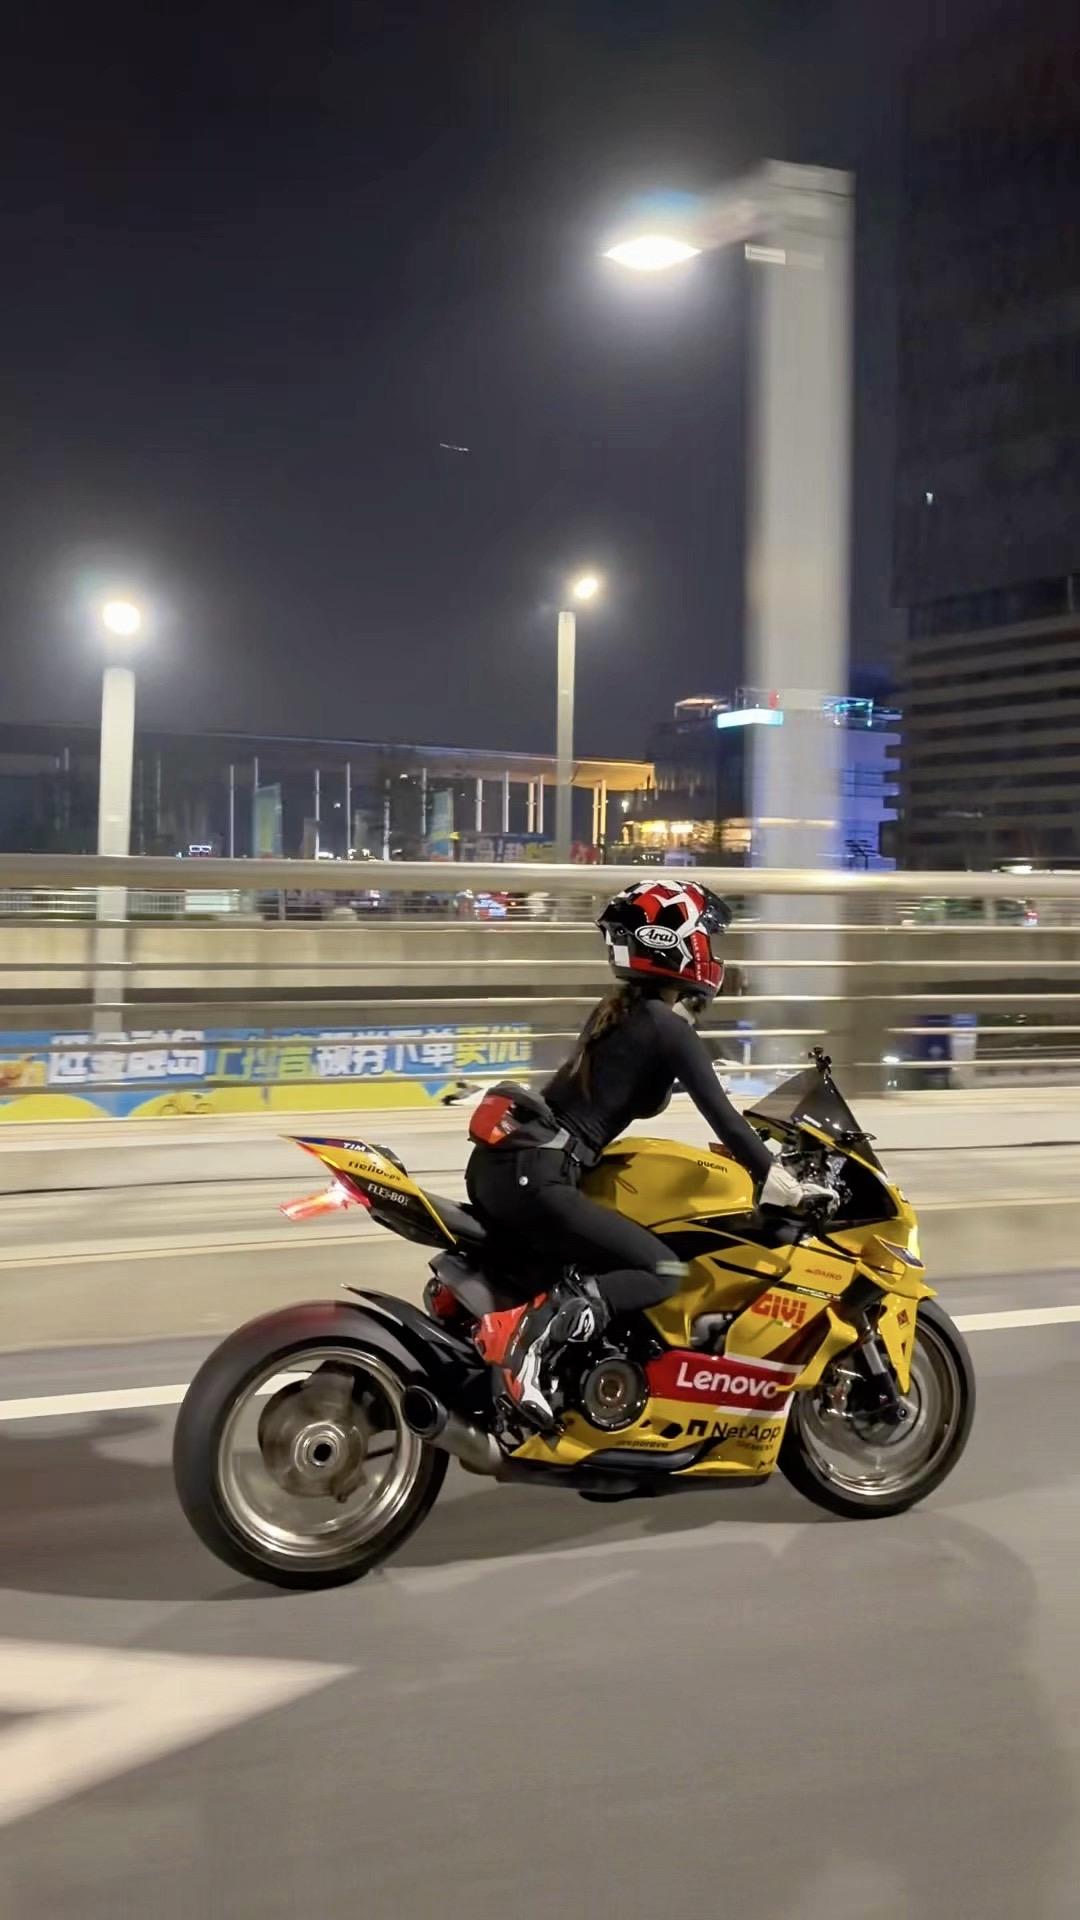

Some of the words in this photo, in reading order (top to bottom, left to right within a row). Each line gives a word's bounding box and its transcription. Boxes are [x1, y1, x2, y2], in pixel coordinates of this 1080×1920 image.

[639, 929, 674, 943] Arai
[343, 1142, 367, 1152] TIM
[751, 1293, 808, 1325] GIVI
[676, 1361, 779, 1400] Lenovo
[712, 1421, 781, 1442] NetApp
